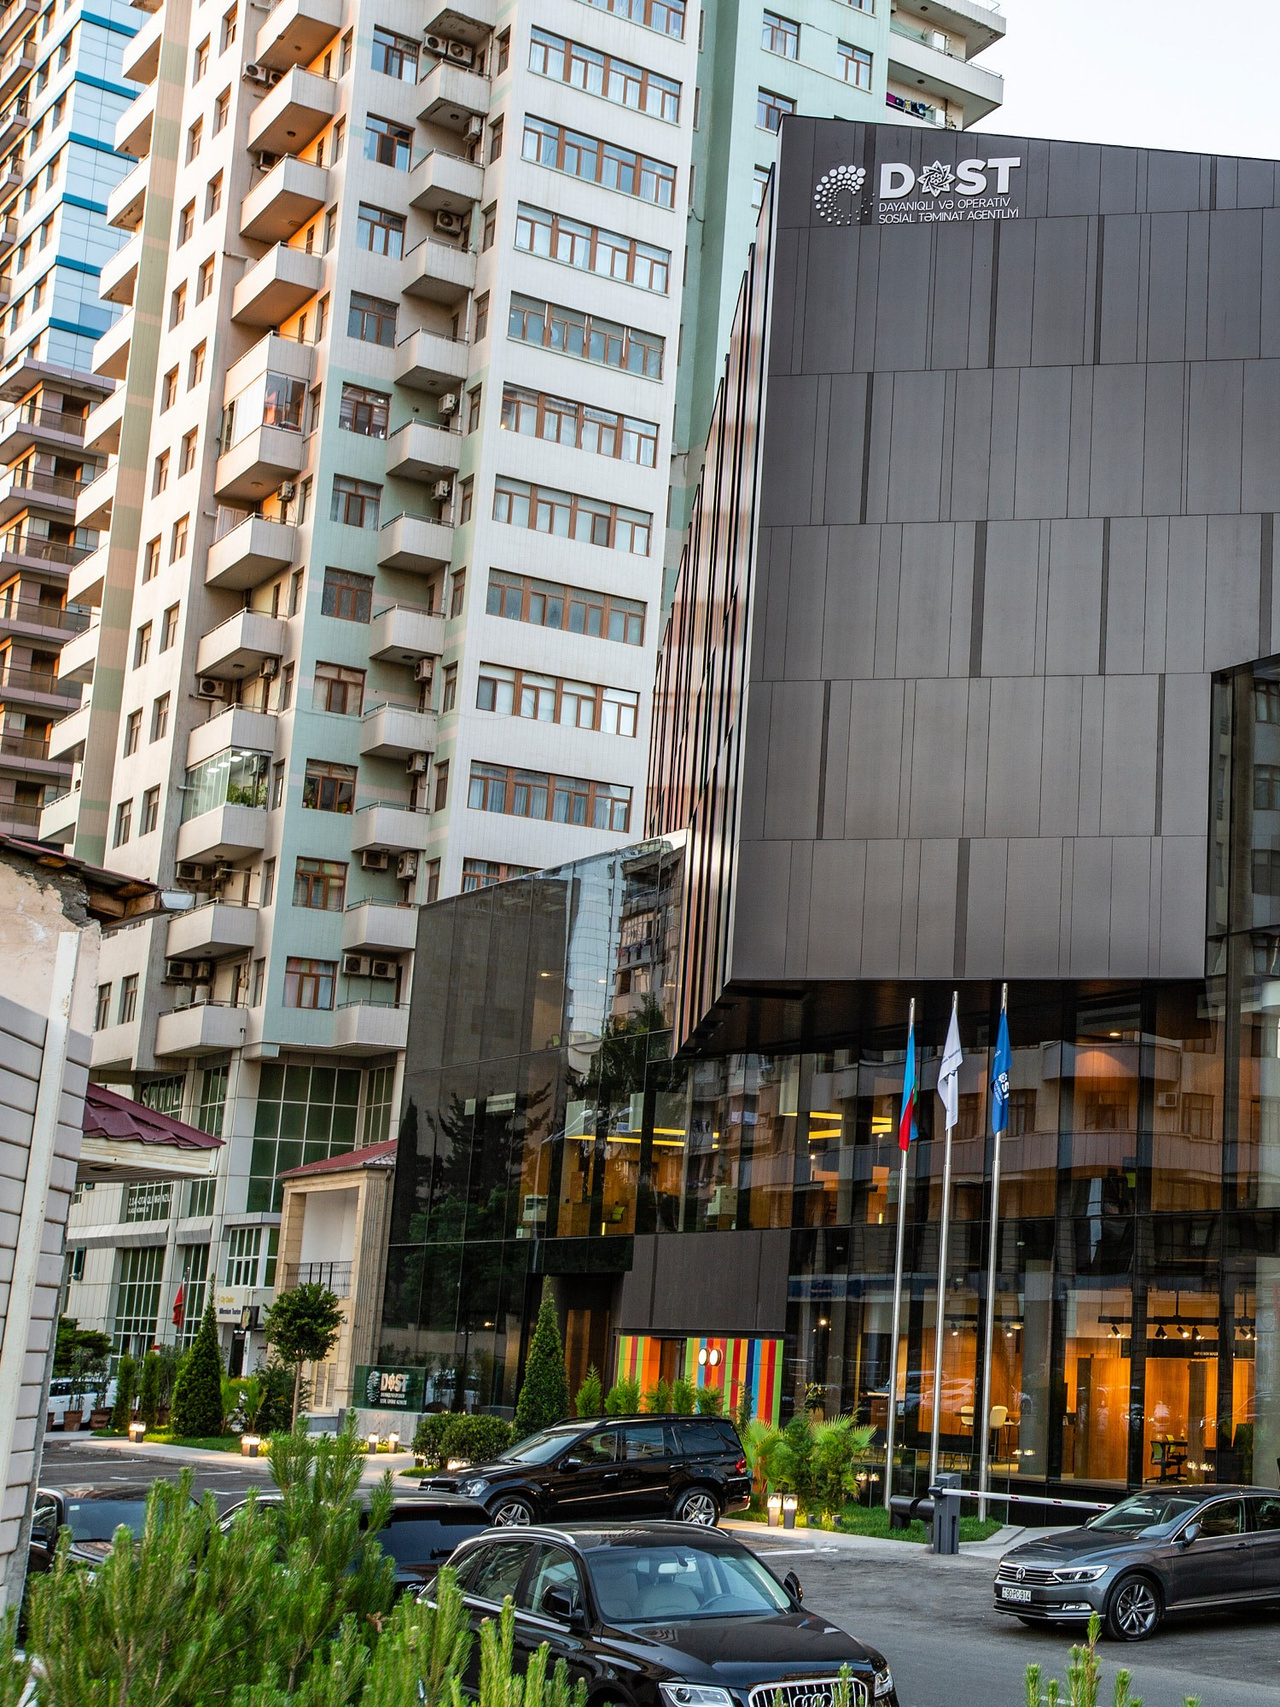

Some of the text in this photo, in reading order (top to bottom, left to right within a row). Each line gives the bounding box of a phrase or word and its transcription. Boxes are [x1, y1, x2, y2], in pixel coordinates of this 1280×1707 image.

[879, 196, 1011, 213] DAYANIQLI VƏ OPERATİV
[878, 212, 916, 225] SOSİAL
